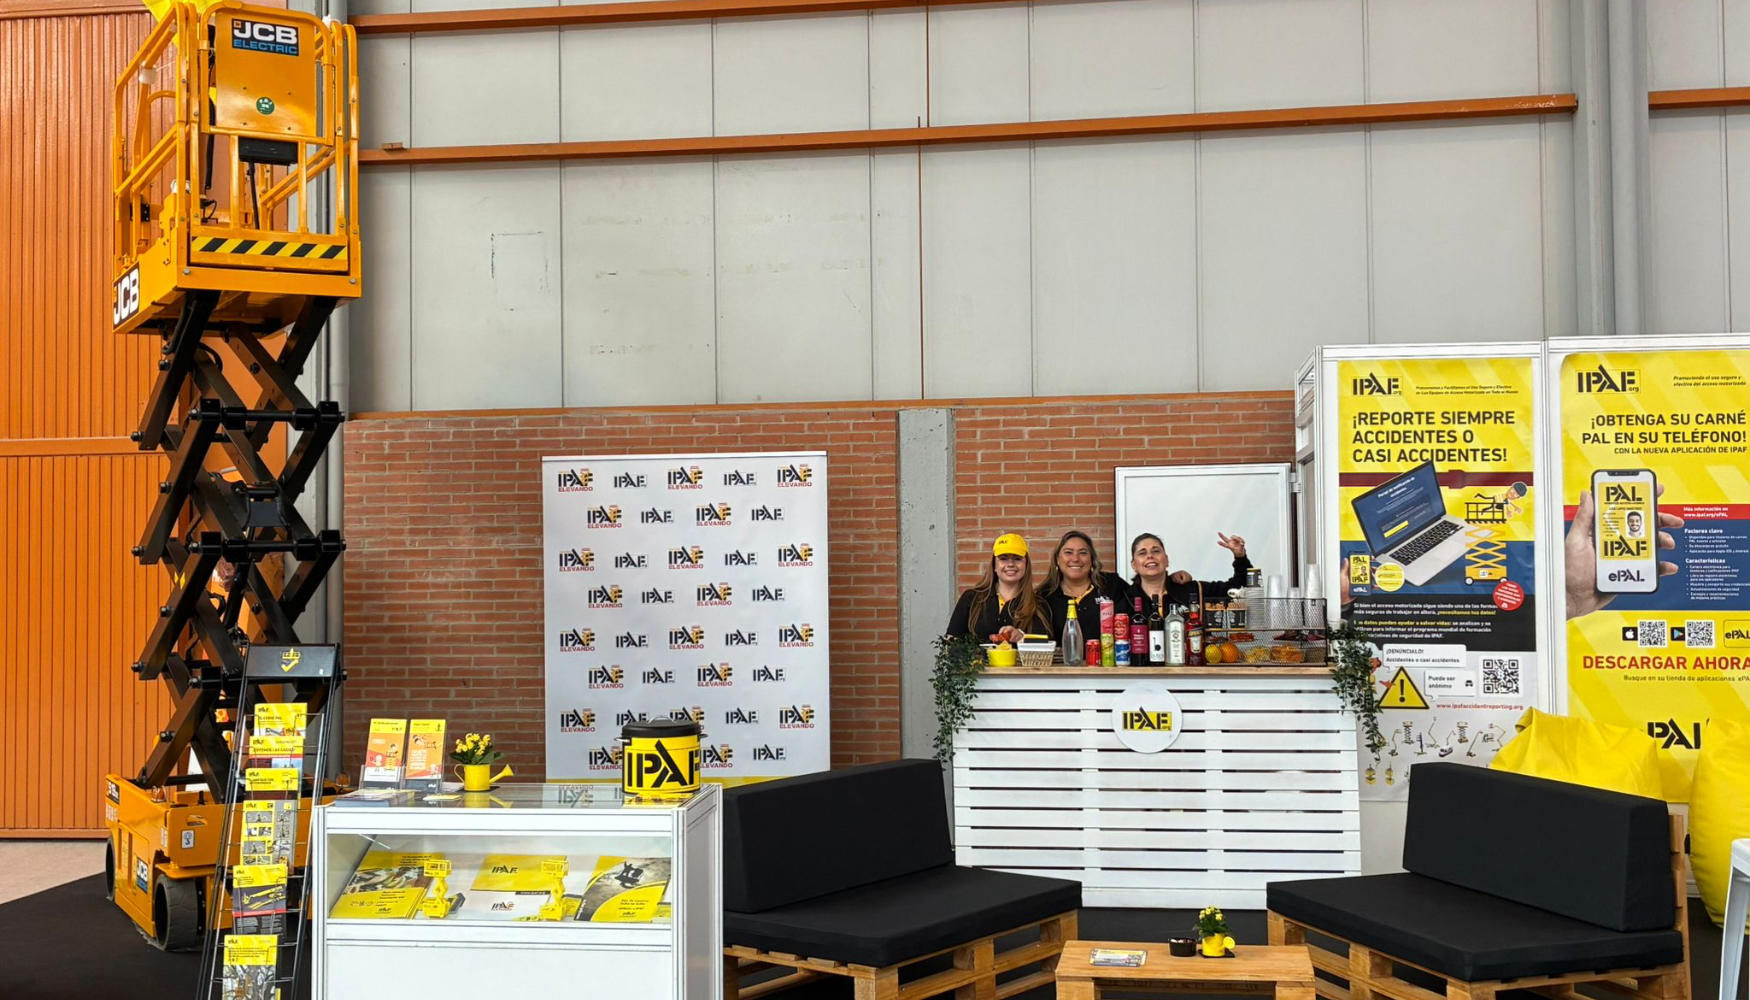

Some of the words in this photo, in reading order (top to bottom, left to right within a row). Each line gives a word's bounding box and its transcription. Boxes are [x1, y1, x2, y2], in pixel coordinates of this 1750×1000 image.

[233, 20, 298, 44] JCB
[233, 39, 298, 54] ELECTRIC
[114, 268, 139, 323] JCB
[1353, 372, 1399, 395] IPAF
[1577, 364, 1636, 393] IPAF
[1353, 411, 1435, 429] ¡REPORTE
[1441, 410, 1515, 425] SIEMPRE
[1591, 414, 1666, 429] ¡OBTENGA
[1671, 414, 1690, 425] SU
[1695, 410, 1746, 425] CARNÉ
[1352, 430, 1458, 444] ACCIDENTES
[1462, 429, 1474, 443] O
[1582, 433, 1610, 444] PAL
[1615, 433, 1634, 443] EN
[1639, 432, 1658, 443] SU
[1663, 428, 1746, 442] TELÉFONO!
[1353, 449, 1391, 462] CASI
[1397, 448, 1507, 462] ACCIDENTES!
[558, 469, 593, 487] IPAF
[667, 466, 703, 484] IPAF
[777, 464, 812, 482] IPAF
[1606, 484, 1643, 501] PAL
[587, 505, 622, 523] IPAF
[696, 503, 731, 521] IPAF
[778, 543, 813, 561] IPAF
[1604, 535, 1647, 556] IPAF
[559, 548, 595, 566] IPAF
[668, 546, 704, 564] IPAF
[1608, 569, 1645, 582] ePAL
[588, 585, 623, 605] IPAF
[641, 587, 674, 603] IPAF
[697, 582, 732, 601] IPAF
[559, 628, 596, 646] IPAF
[615, 631, 648, 647] IPAF
[669, 626, 704, 644] IPAF
[779, 624, 814, 642] IPAF
[1583, 656, 1687, 669] DESCARGAR
[588, 665, 624, 684] IPAF
[697, 663, 733, 681] IPAF
[560, 708, 596, 727] IPAF
[725, 707, 758, 723] IPAF
[779, 705, 815, 723] IPAF
[1123, 706, 1169, 730] IPAF
[627, 740, 700, 788] IPAF
[492, 864, 518, 874] IPAF
